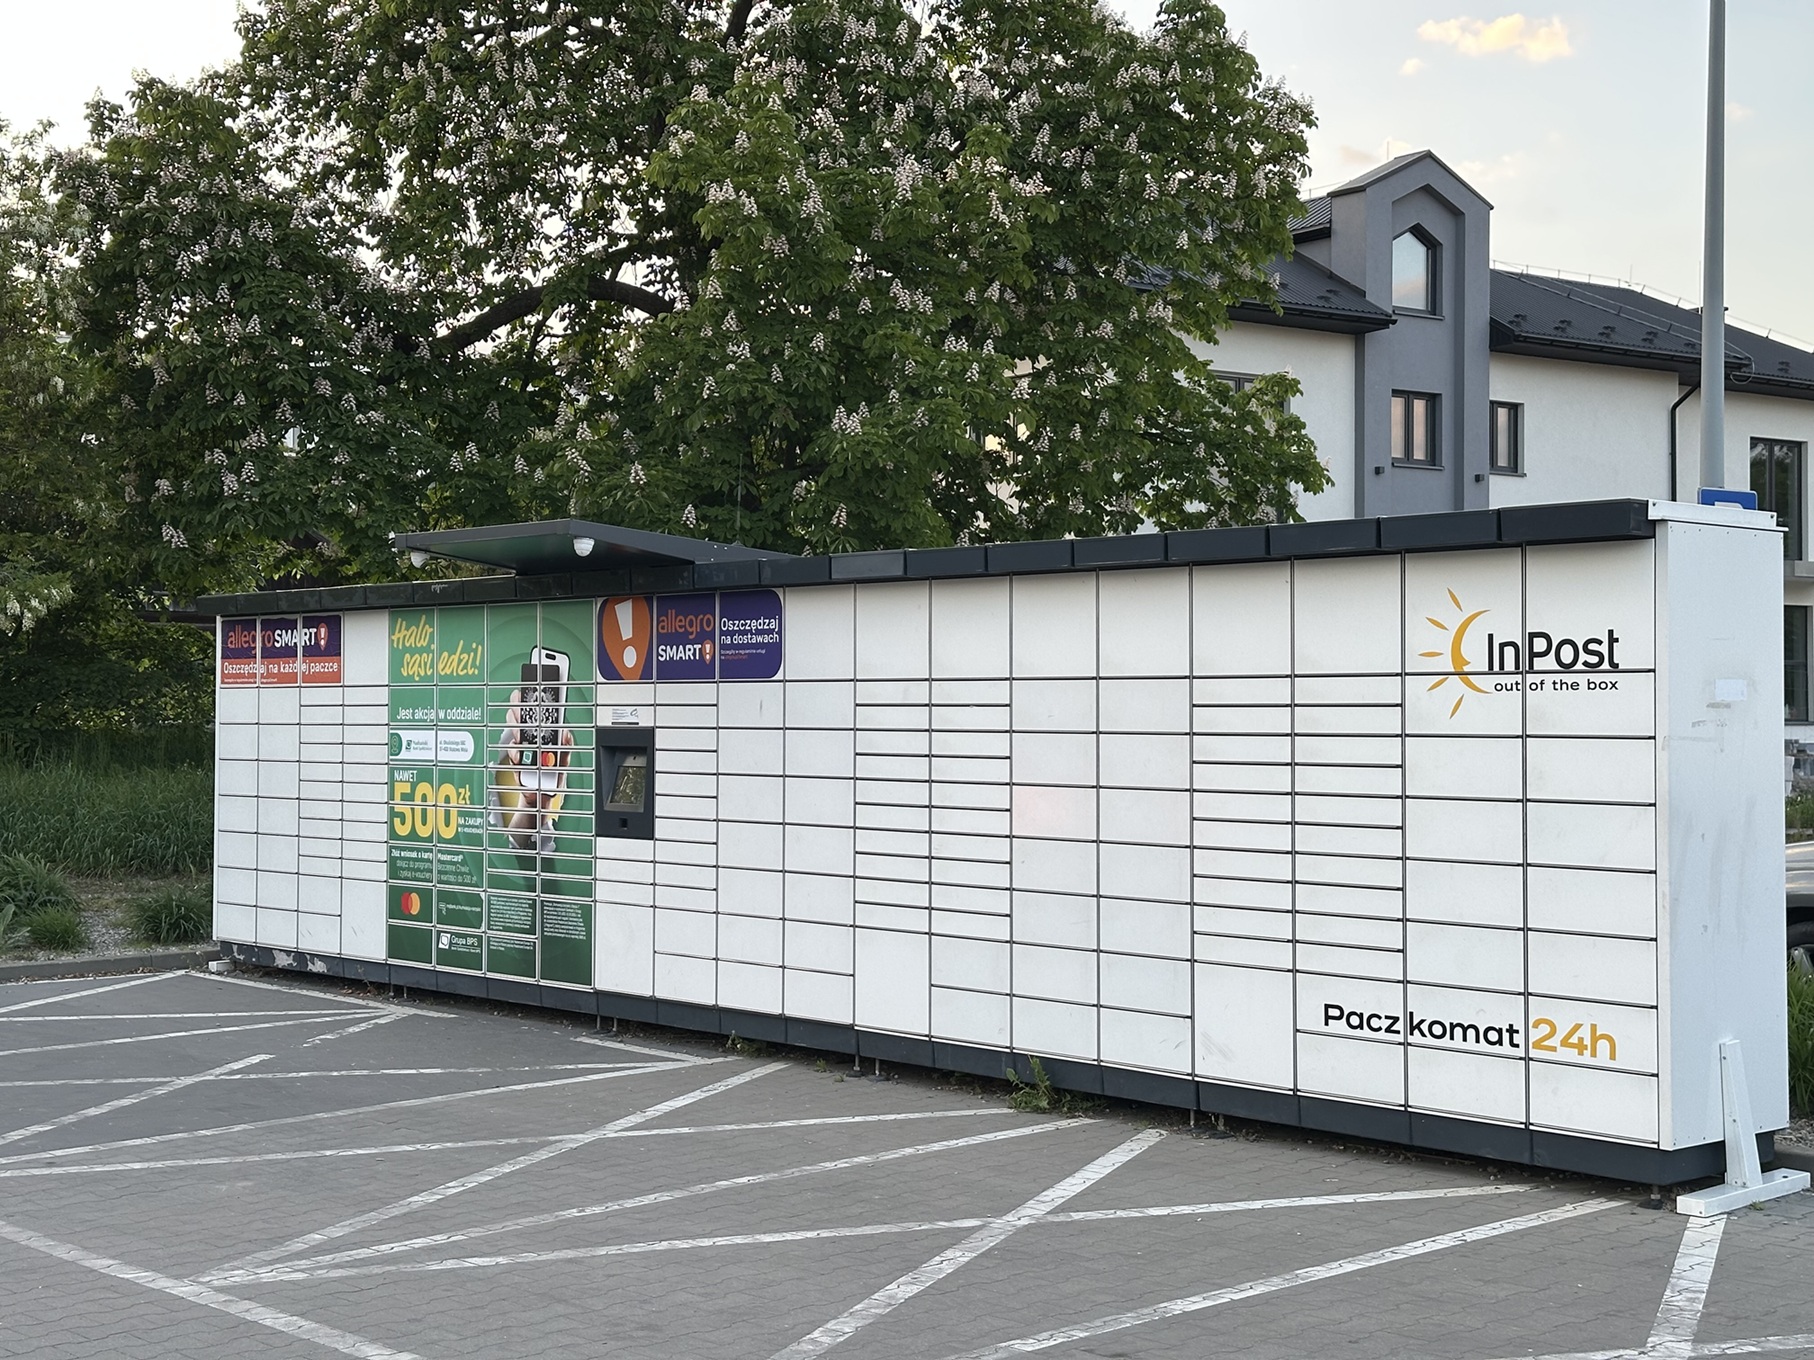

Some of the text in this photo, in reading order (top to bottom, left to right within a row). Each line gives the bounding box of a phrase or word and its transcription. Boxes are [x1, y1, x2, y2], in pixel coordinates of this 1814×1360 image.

[391, 615, 433, 649] Halo
[658, 609, 714, 639] allegro
[721, 615, 779, 633] Oszczędzaj
[721, 631, 779, 644] na dostawach
[1487, 629, 1620, 672] InPost
[224, 660, 338, 676] Oszczędzaj na każdej paczce
[1494, 678, 1619, 692] out of the box
[396, 706, 482, 722] Jest akcja w oddziale!
[394, 769, 417, 782] NAWET
[393, 782, 470, 839] 500 zł
[451, 935, 478, 946] Grupa BPS
[1323, 1002, 1617, 1061] Paczkomat 24h
